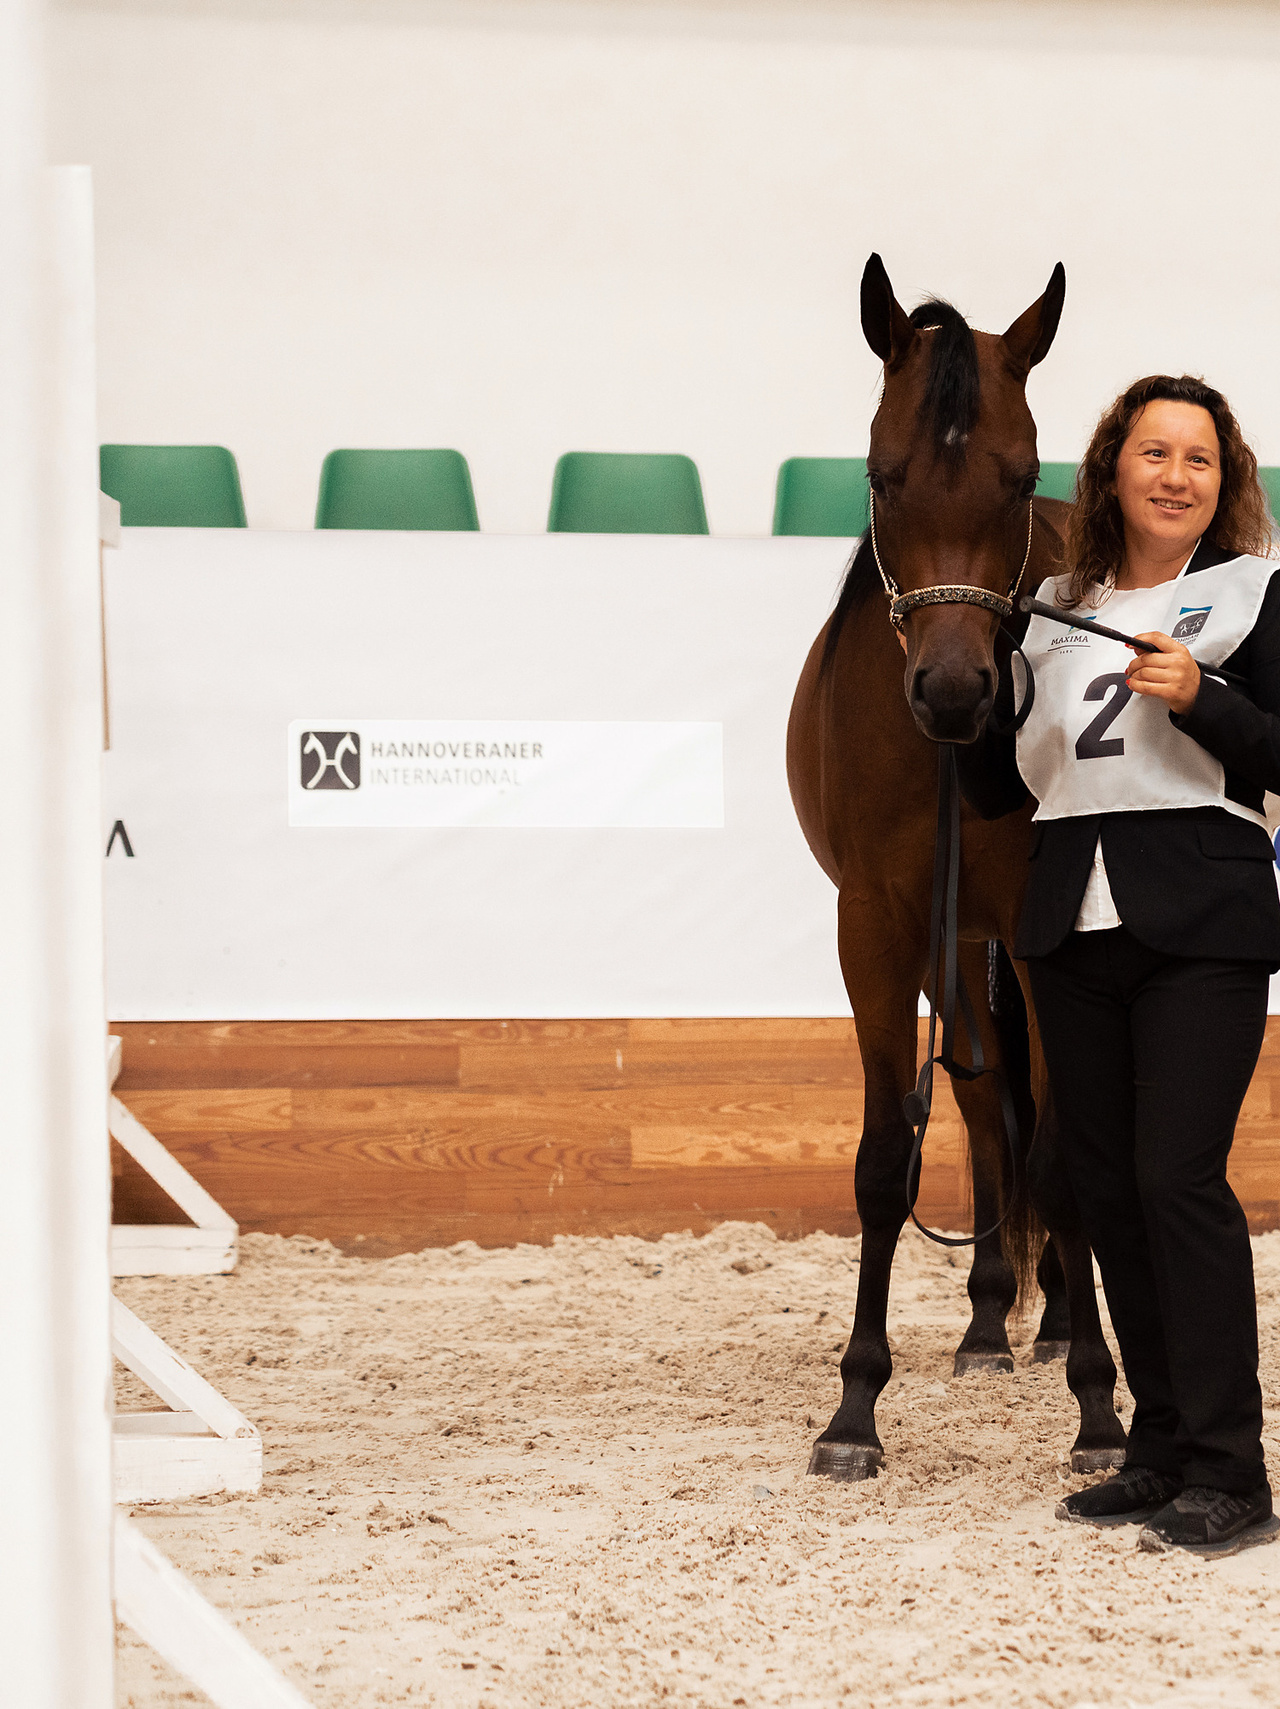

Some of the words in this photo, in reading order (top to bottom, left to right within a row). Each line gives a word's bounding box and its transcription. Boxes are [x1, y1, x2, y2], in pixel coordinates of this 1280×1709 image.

[1051, 635, 1089, 646] MAXIMA
[1075, 672, 1134, 761] 2
[371, 741, 544, 759] HANNOVERANER
[370, 767, 524, 786] INTERNATIONAL
